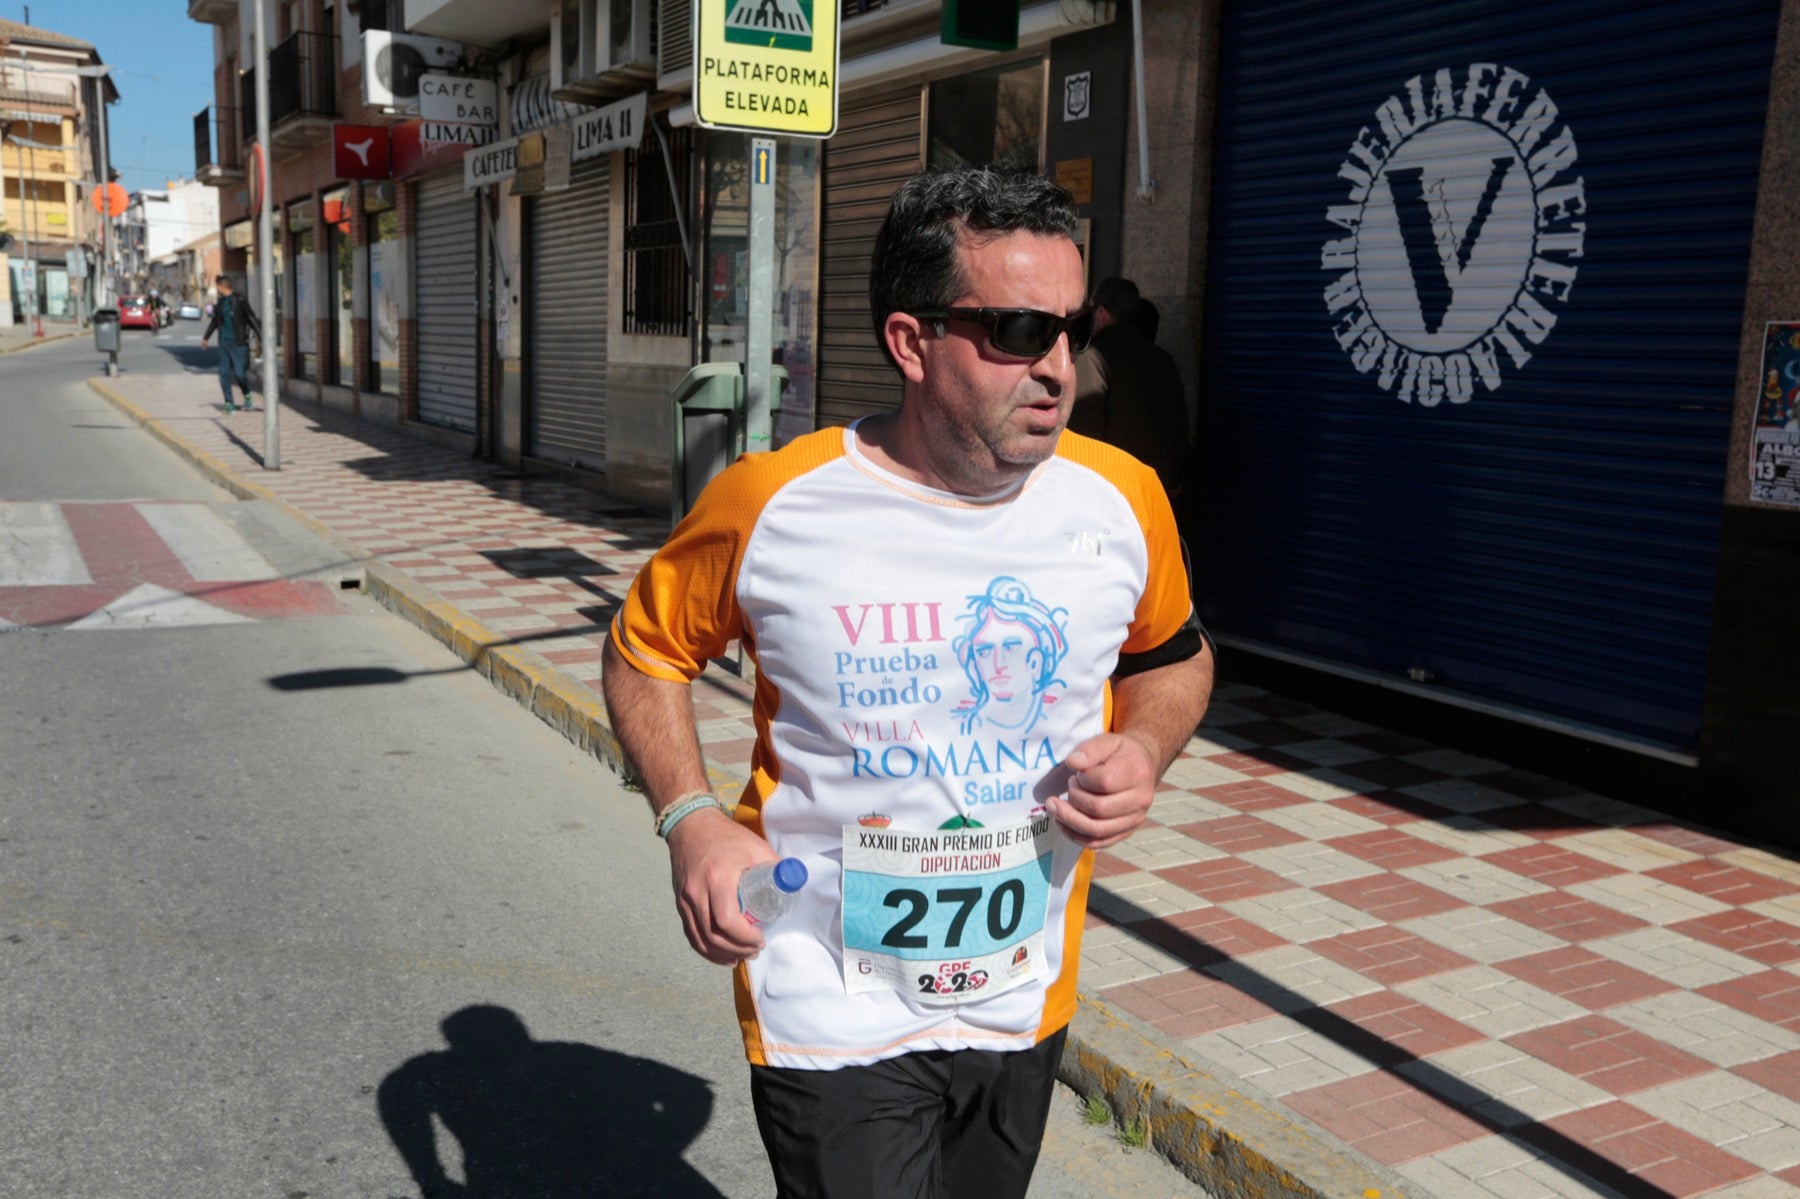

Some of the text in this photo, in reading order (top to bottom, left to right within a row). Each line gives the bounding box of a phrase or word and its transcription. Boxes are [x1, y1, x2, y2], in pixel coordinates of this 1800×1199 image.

[704, 57, 830, 89] PLATAFORMA
[422, 81, 476, 99] CAFÉ
[456, 104, 494, 120] BAR
[724, 91, 810, 117] ELEVADA
[577, 115, 613, 150] LIMA
[620, 108, 632, 138] II
[1756, 461, 1775, 480] 13
[831, 602, 946, 646] VIII
[834, 648, 938, 676] Prueba
[836, 677, 942, 709] Fondo
[881, 676, 894, 686] de
[841, 720, 925, 742] VILLA
[852, 736, 1060, 778] ROMANA
[964, 779, 1027, 806] Salar
[859, 816, 1050, 853] XXXIII GRAN PREMIO DE FONDO
[920, 851, 1001, 873] DIPUTACIÓN
[881, 878, 1025, 948] 270
